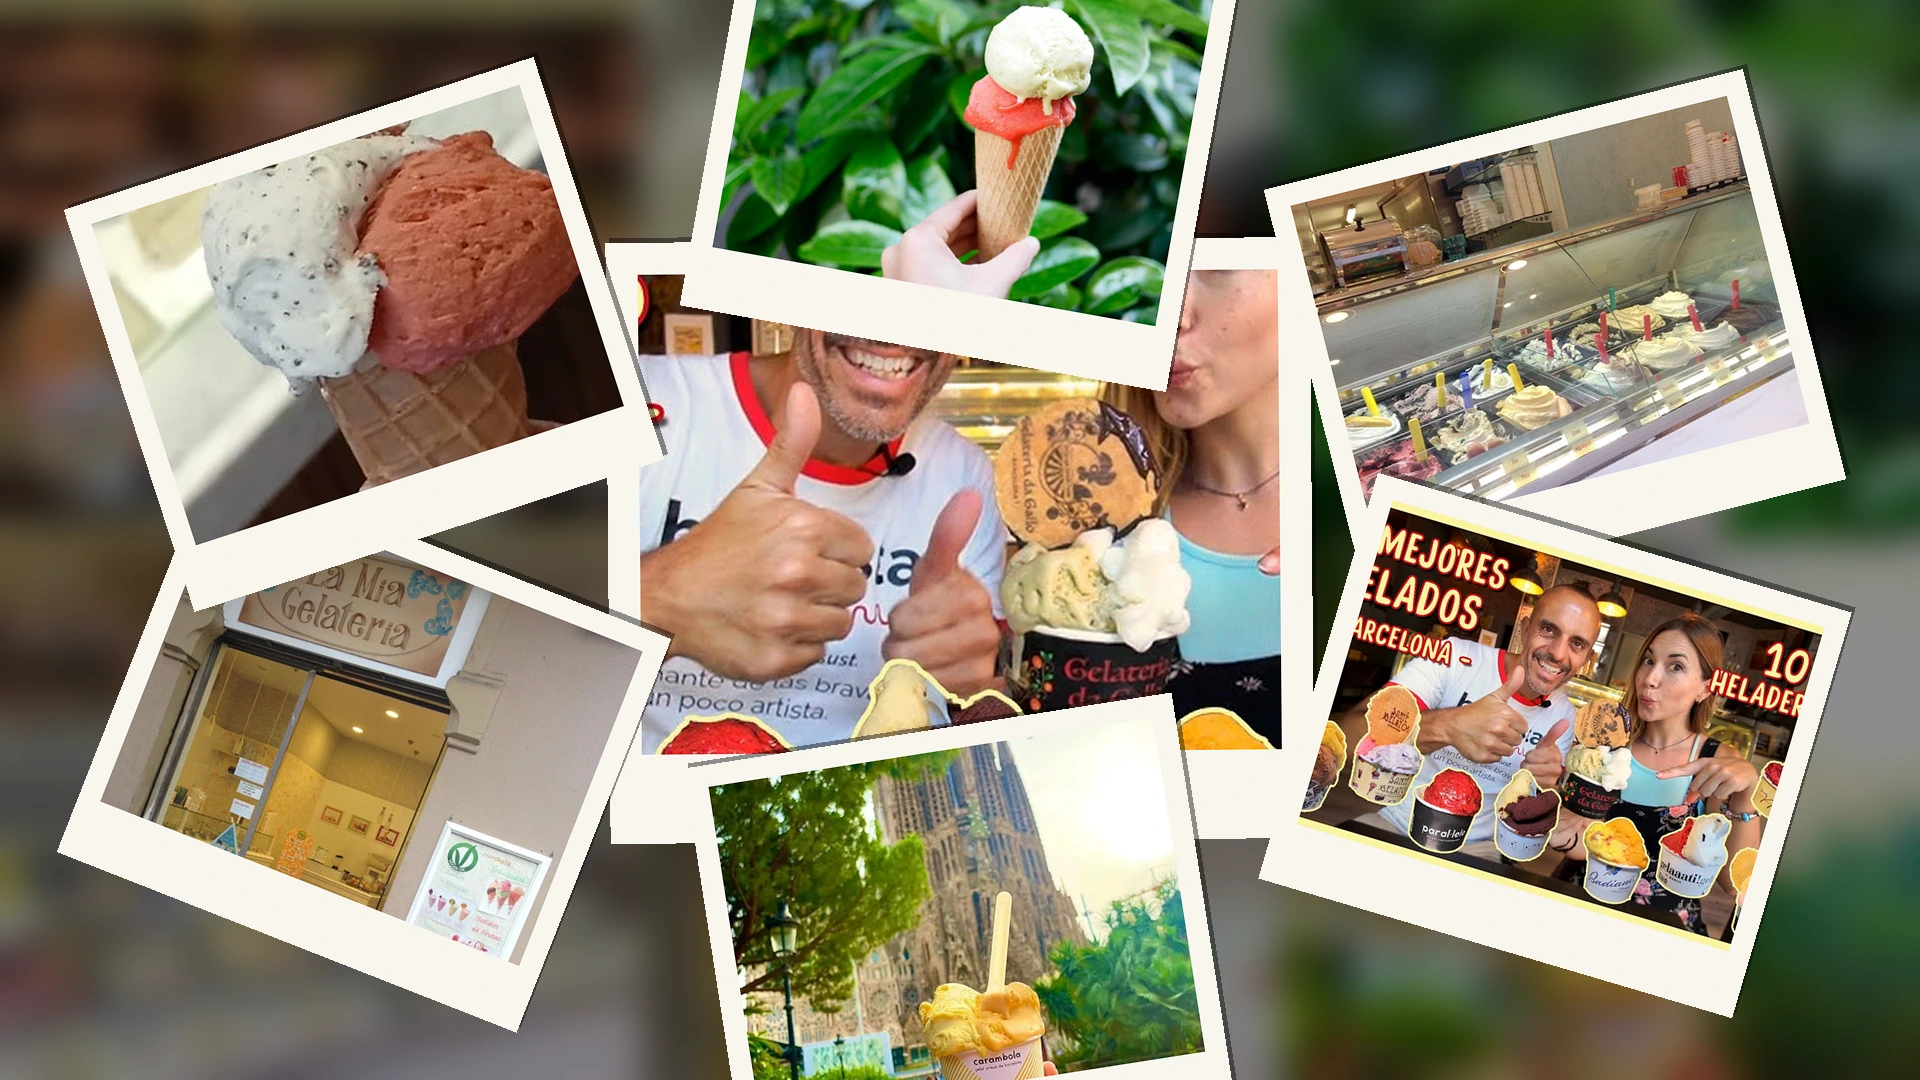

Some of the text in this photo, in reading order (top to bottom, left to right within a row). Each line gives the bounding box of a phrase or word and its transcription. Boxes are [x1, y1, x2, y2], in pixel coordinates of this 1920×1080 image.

[351, 563, 405, 607] Mia
[281, 586, 411, 650] Gelateria
[678, 694, 744, 713] poco
[750, 699, 829, 720] artista.
[1445, 758, 1469, 771] poco
[973, 1050, 1022, 1066] carambola
